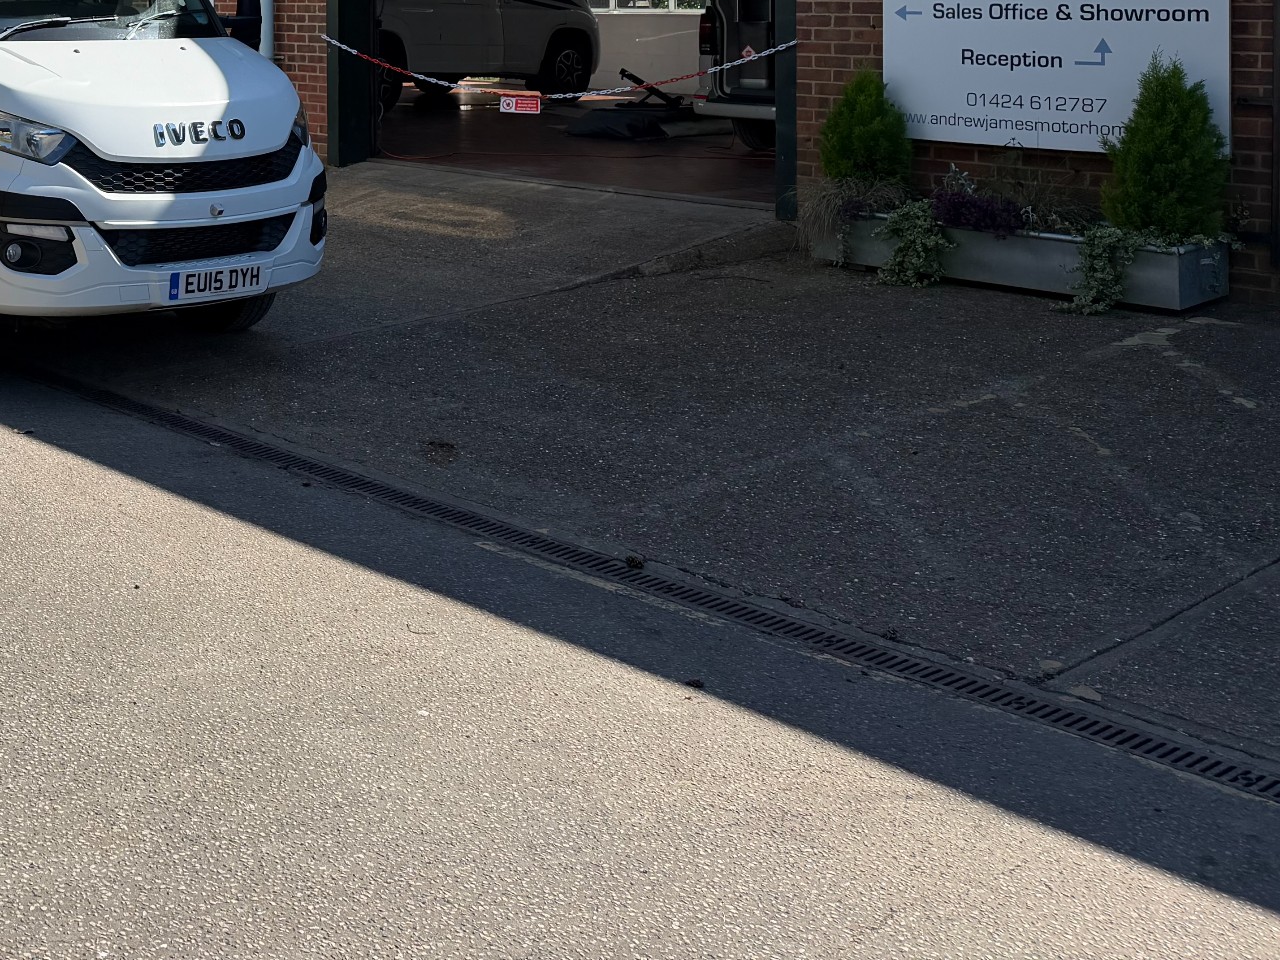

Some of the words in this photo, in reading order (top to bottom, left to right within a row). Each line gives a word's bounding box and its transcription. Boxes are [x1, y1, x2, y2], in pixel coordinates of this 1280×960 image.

[932, 2, 983, 20] Sales
[988, 3, 1049, 21] Office
[1055, 3, 1073, 22] &
[1079, 3, 1210, 22] Showroom
[961, 48, 1063, 72] Reception
[966, 92, 1025, 109] 01424
[1030, 95, 1108, 114] 612787
[153, 118, 246, 148] IVECO
[902, 112, 1125, 137] ww.andrewjamesmotorhom
[184, 270, 224, 295] EU15
[228, 266, 261, 290] DYH
